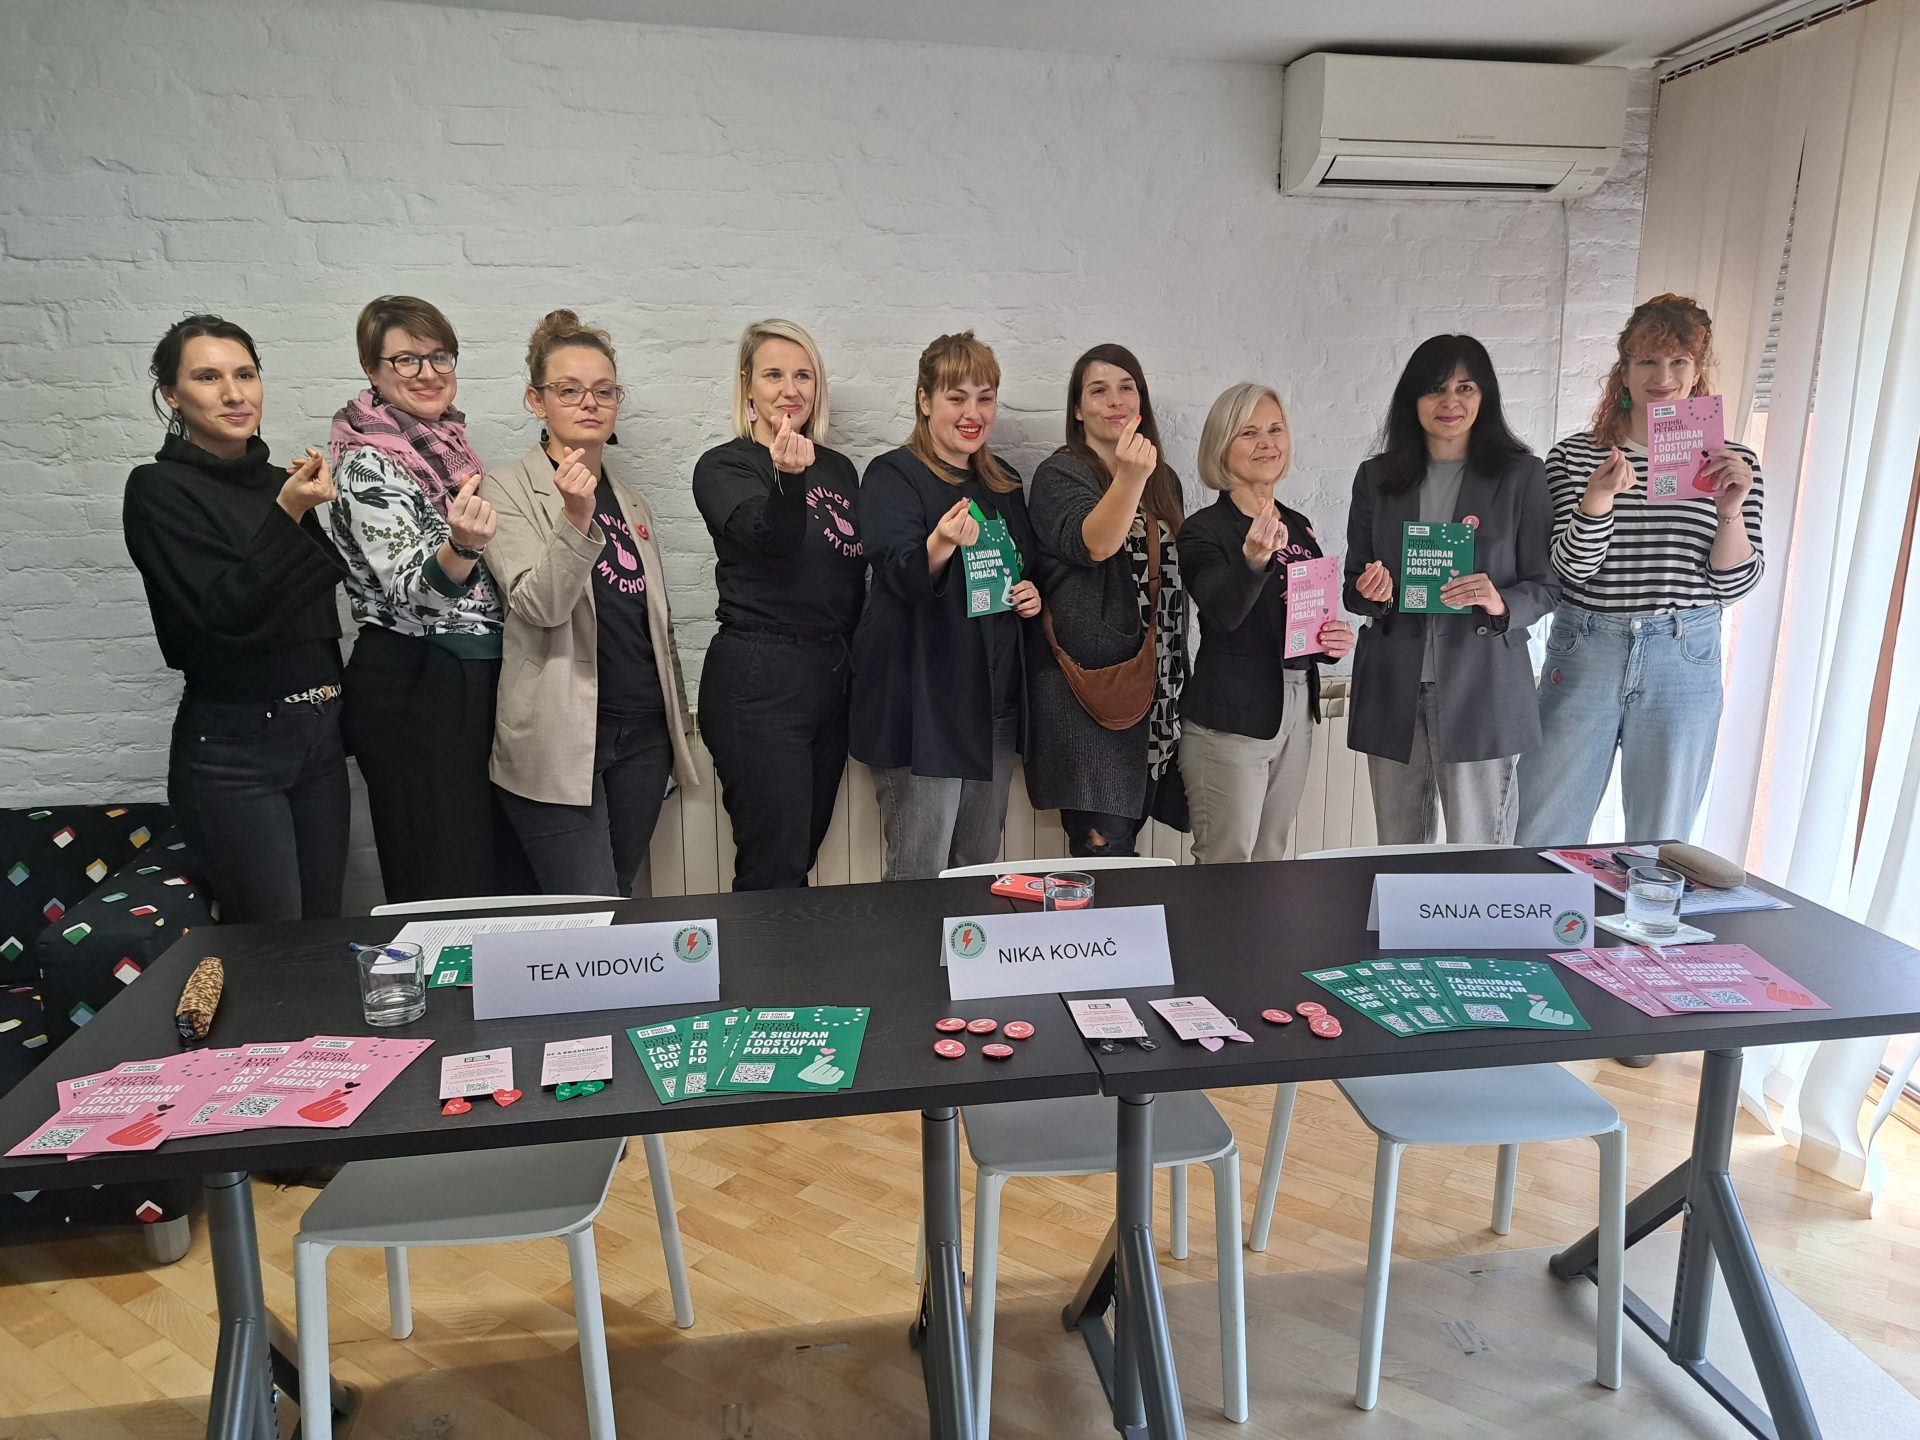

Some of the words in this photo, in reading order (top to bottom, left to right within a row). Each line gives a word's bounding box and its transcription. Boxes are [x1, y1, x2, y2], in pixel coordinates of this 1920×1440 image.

[1654, 433, 1665, 442] ZA
[1666, 430, 1703, 441] SIGURAN
[1659, 440, 1703, 452] DOSTUPAN
[1654, 451, 1691, 463] POBAČAJ
[599, 514, 634, 540] VOIC
[823, 527, 841, 549] MY
[843, 542, 864, 557] CHO
[967, 552, 976, 560] ZA
[976, 549, 1001, 559] SIGURAN
[1286, 544, 1314, 559] VOIC
[1419, 550, 1453, 558] SIGURAN
[969, 562, 971, 570] I
[972, 558, 1003, 570] DOSTUPAN
[1411, 558, 1452, 567] DOSTUPAN
[597, 560, 618, 584] MY
[619, 575, 646, 593] CHO
[1407, 566, 1440, 577] POBAČAJ
[1419, 903, 1480, 919] SANJA
[1486, 903, 1552, 918] CESAR
[998, 946, 1045, 964] NIKA
[1050, 937, 1118, 961] KOVAČ
[527, 963, 568, 981] TEA
[575, 952, 665, 978] VIDOVIĆ
[1465, 978, 1523, 986] SIGURAN
[1458, 984, 1528, 993] DOSTUPAN
[1454, 990, 1513, 1000] POBAČAJ
[646, 1047, 665, 1055] ZA
[743, 1045, 803, 1056] POBAČAJ
[307, 1061, 371, 1071] SIGURAN
[284, 1069, 361, 1080] DOSTUPAN
[265, 1077, 330, 1088] POBAČAJ
[90, 1087, 114, 1096] ZA
[114, 1085, 185, 1094] SIGURAN
[80, 1097, 88, 1105] I
[91, 1094, 175, 1104] DOSTUPAN
[68, 1103, 140, 1115] POBAČAJ
